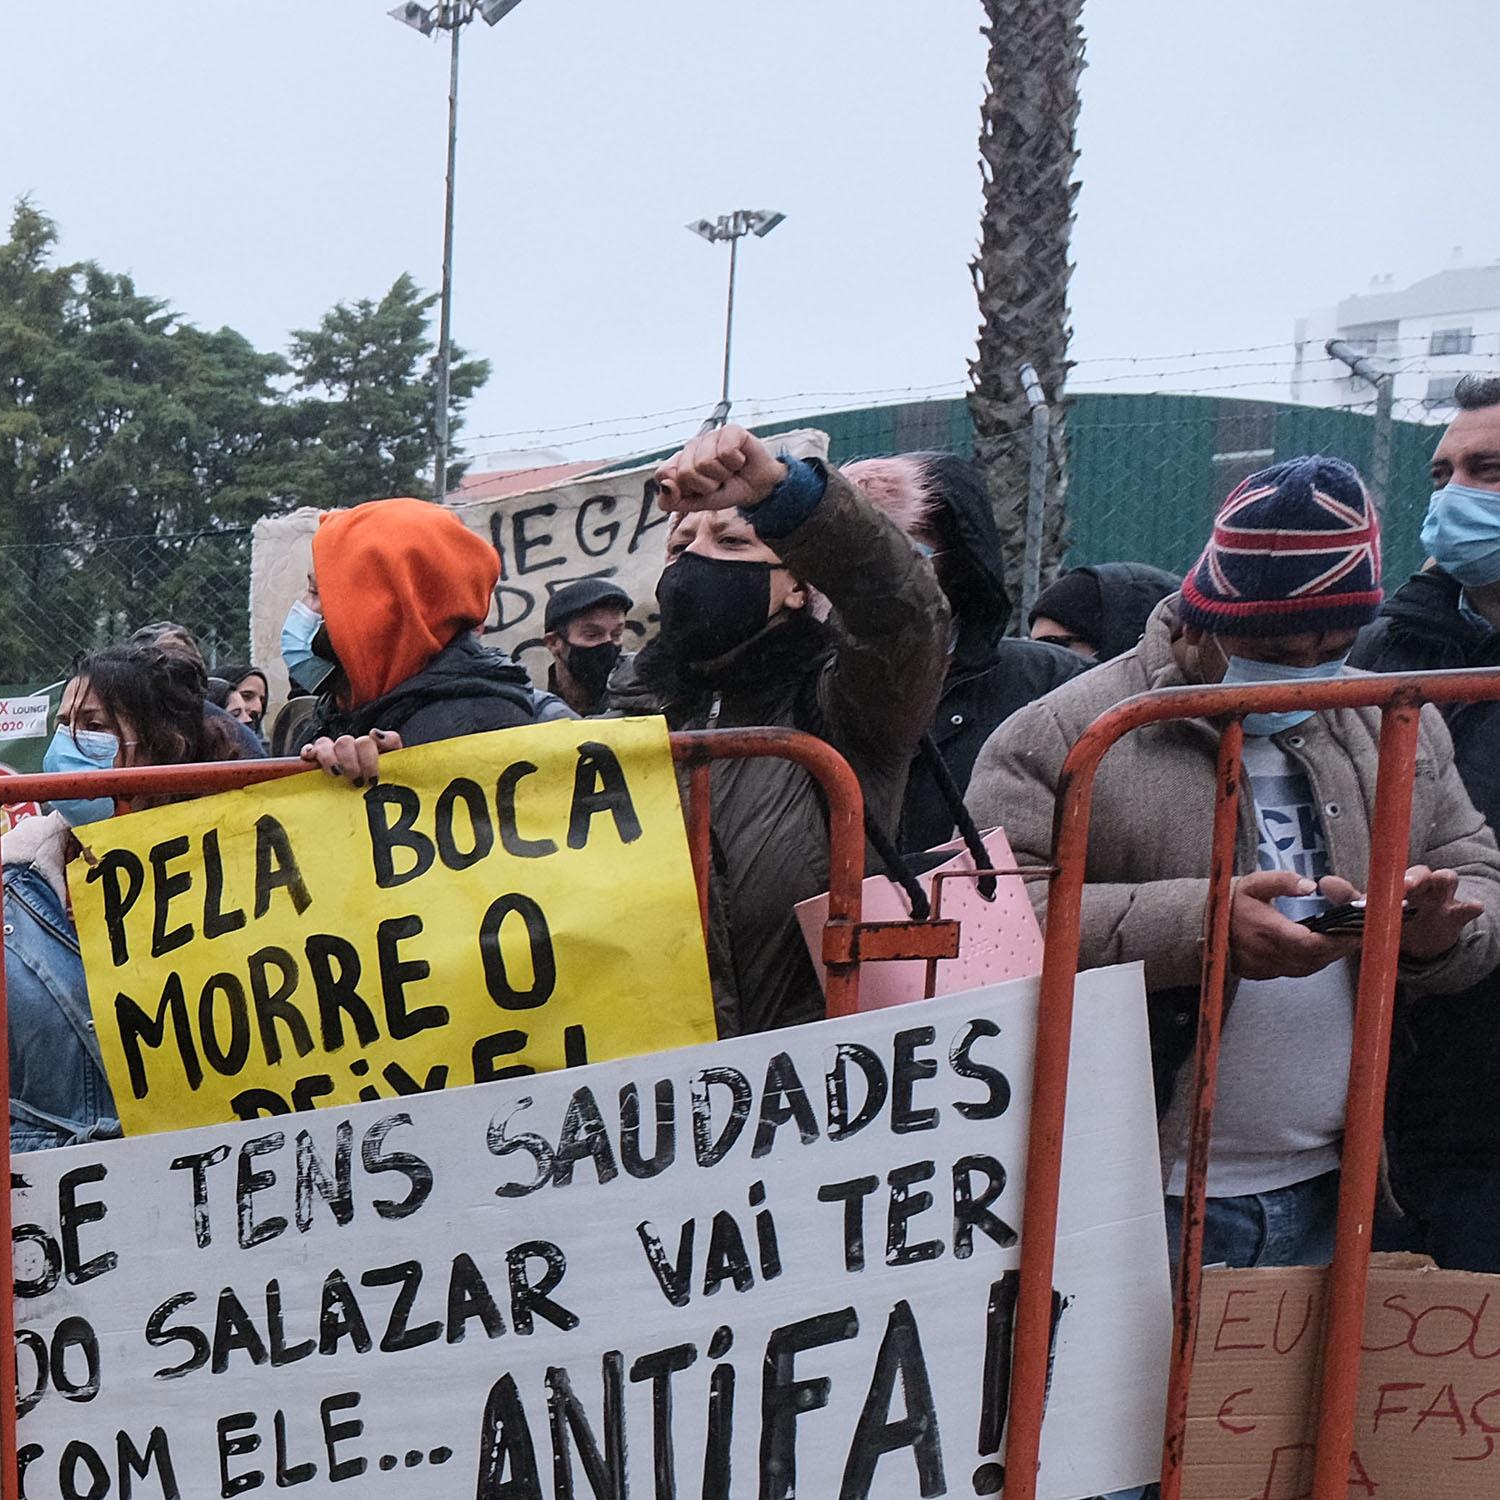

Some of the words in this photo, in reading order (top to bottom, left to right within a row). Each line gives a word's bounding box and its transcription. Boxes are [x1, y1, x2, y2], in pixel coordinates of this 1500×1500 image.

[86, 813, 313, 967] PELA
[363, 740, 644, 890] BOCA
[114, 914, 450, 1100] MORRE
[479, 892, 557, 1011] O
[168, 1112, 434, 1250] TENS
[485, 1018, 1012, 1199] SAUDADES
[14, 1316, 100, 1420] DO
[145, 1239, 580, 1381] SALAZAR
[817, 1153, 1019, 1273] TER
[1213, 1288, 1314, 1355] EU
[216, 1390, 453, 1500] ELE...
